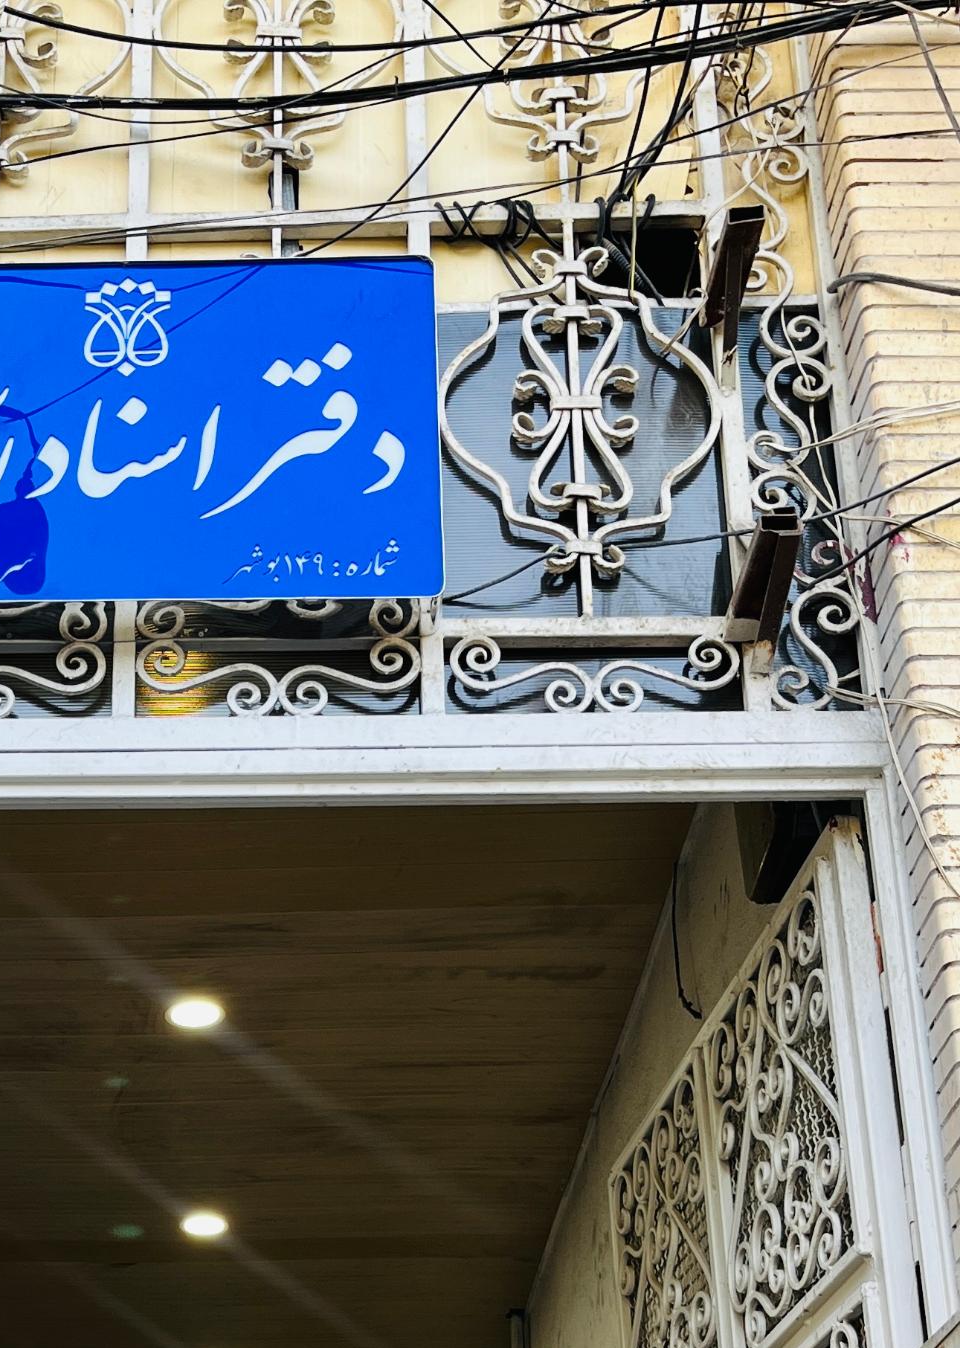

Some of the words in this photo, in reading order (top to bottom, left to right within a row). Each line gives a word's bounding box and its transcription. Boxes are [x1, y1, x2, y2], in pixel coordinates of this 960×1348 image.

[24, 396, 222, 500] اسناد
[200, 342, 407, 519] دفتر
[224, 545, 281, 584] بوشهر
[283, 552, 324, 577] ۱۴۹
